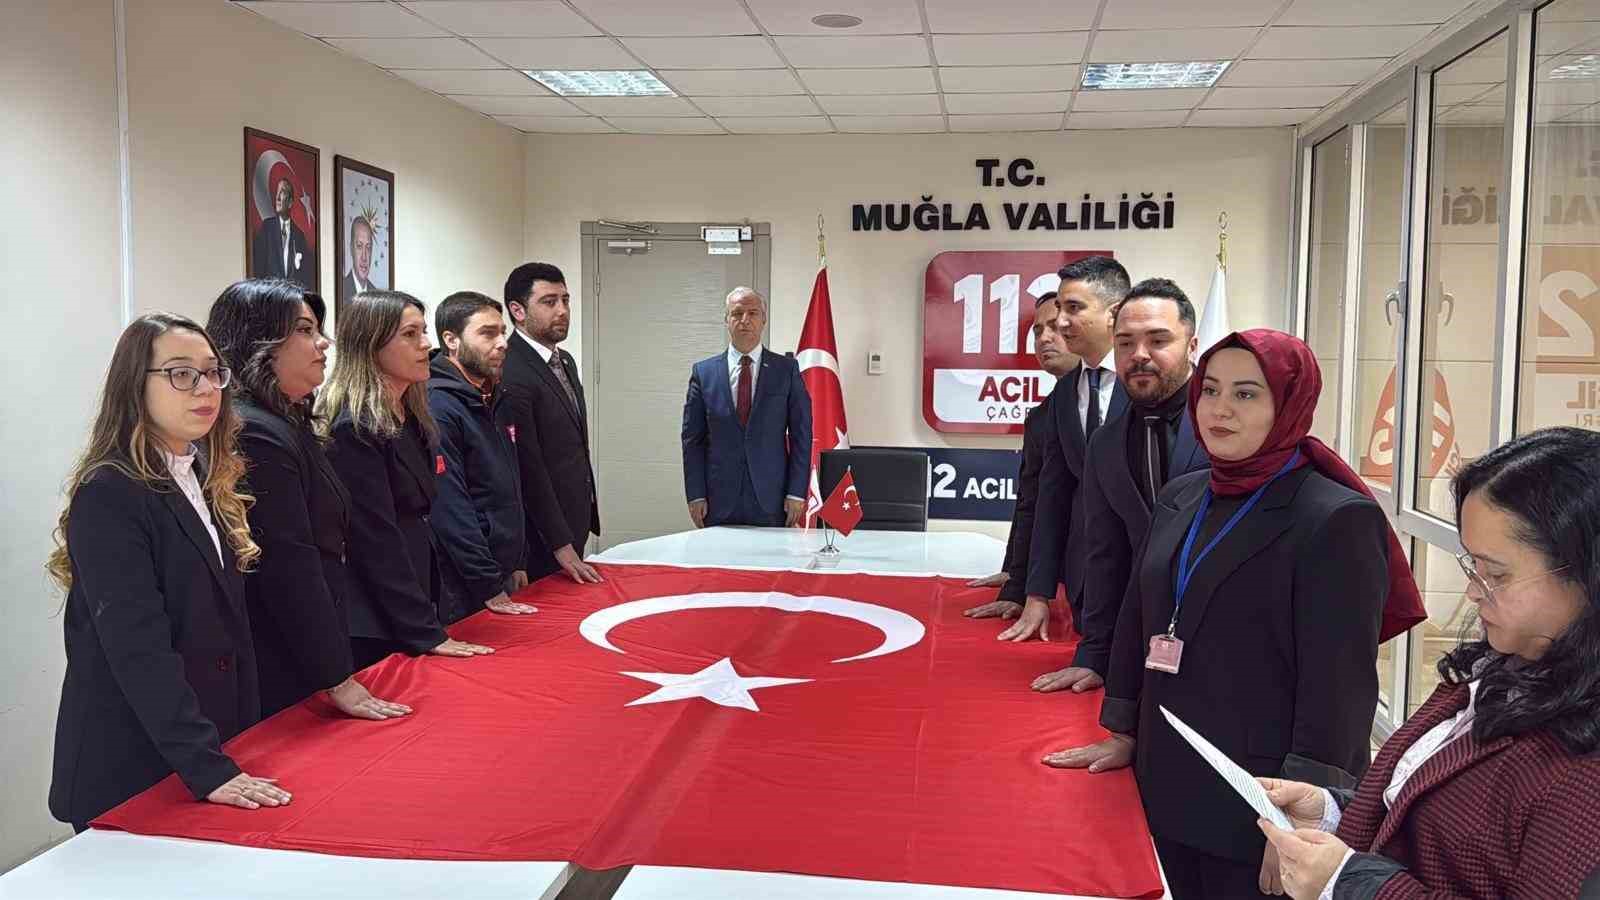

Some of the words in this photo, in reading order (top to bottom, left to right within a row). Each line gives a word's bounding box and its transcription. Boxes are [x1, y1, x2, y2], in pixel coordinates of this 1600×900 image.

[976, 158, 1045, 187] T.C.
[852, 195, 990, 231] MUĞLA
[1003, 192, 1175, 230] VALİLİĞİ
[978, 375, 1046, 403] ACİL
[963, 477, 1018, 500] ACİL
